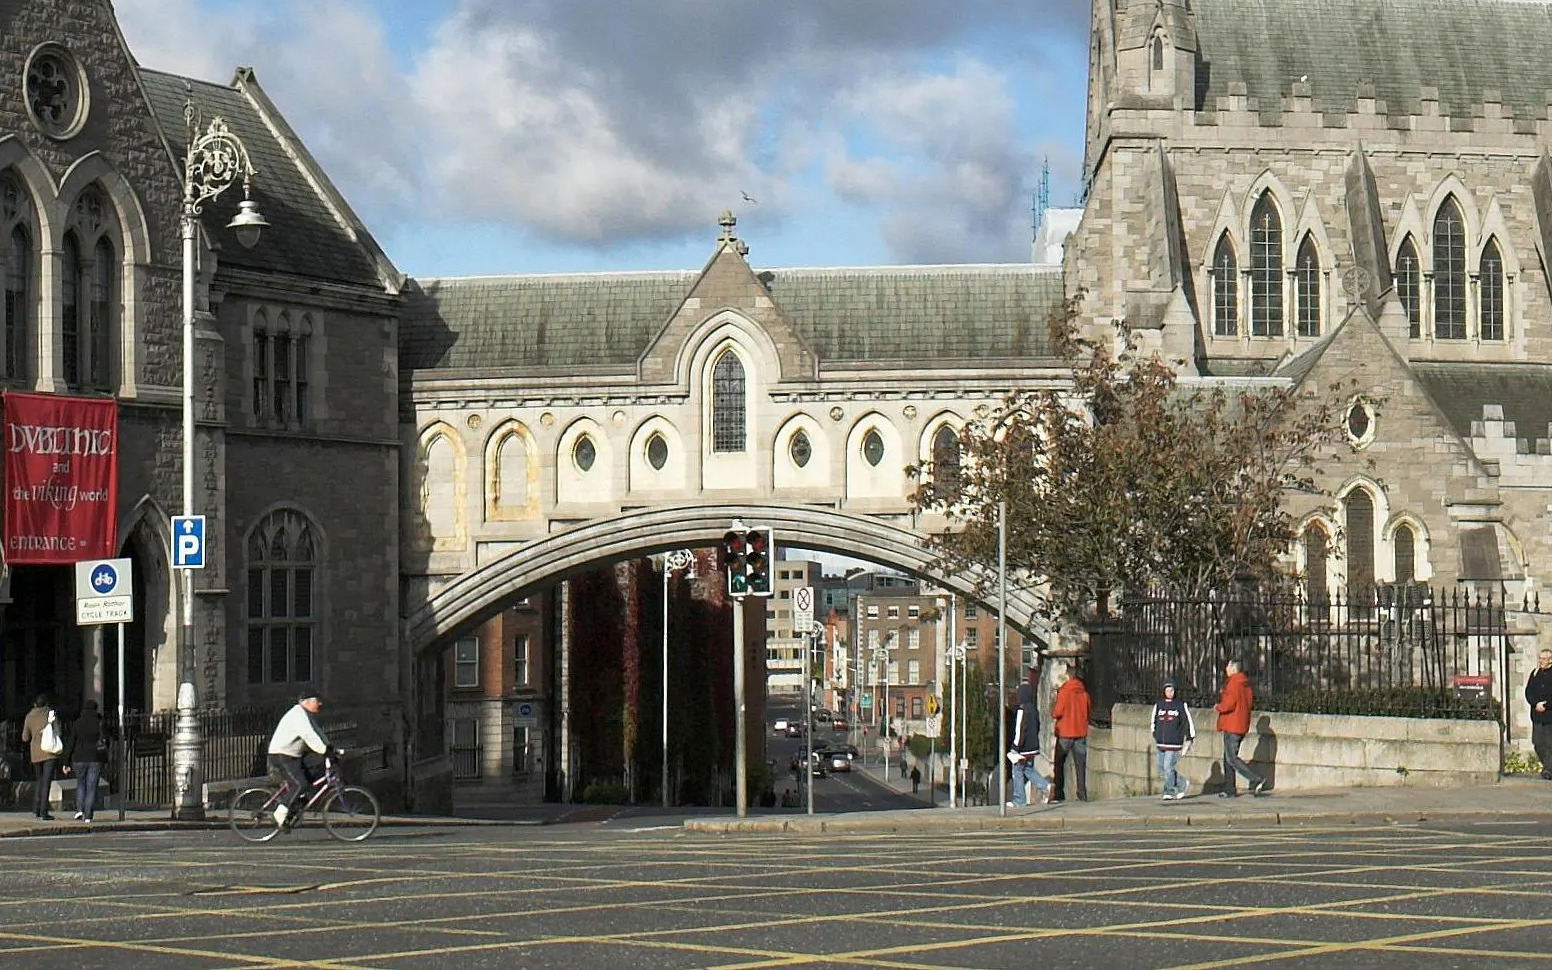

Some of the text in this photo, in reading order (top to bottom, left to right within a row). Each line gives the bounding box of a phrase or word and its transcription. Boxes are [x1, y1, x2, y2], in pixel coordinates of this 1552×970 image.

[53, 460, 70, 473] and
[13, 486, 31, 501] the
[79, 488, 108, 502] world
[179, 534, 199, 565] P
